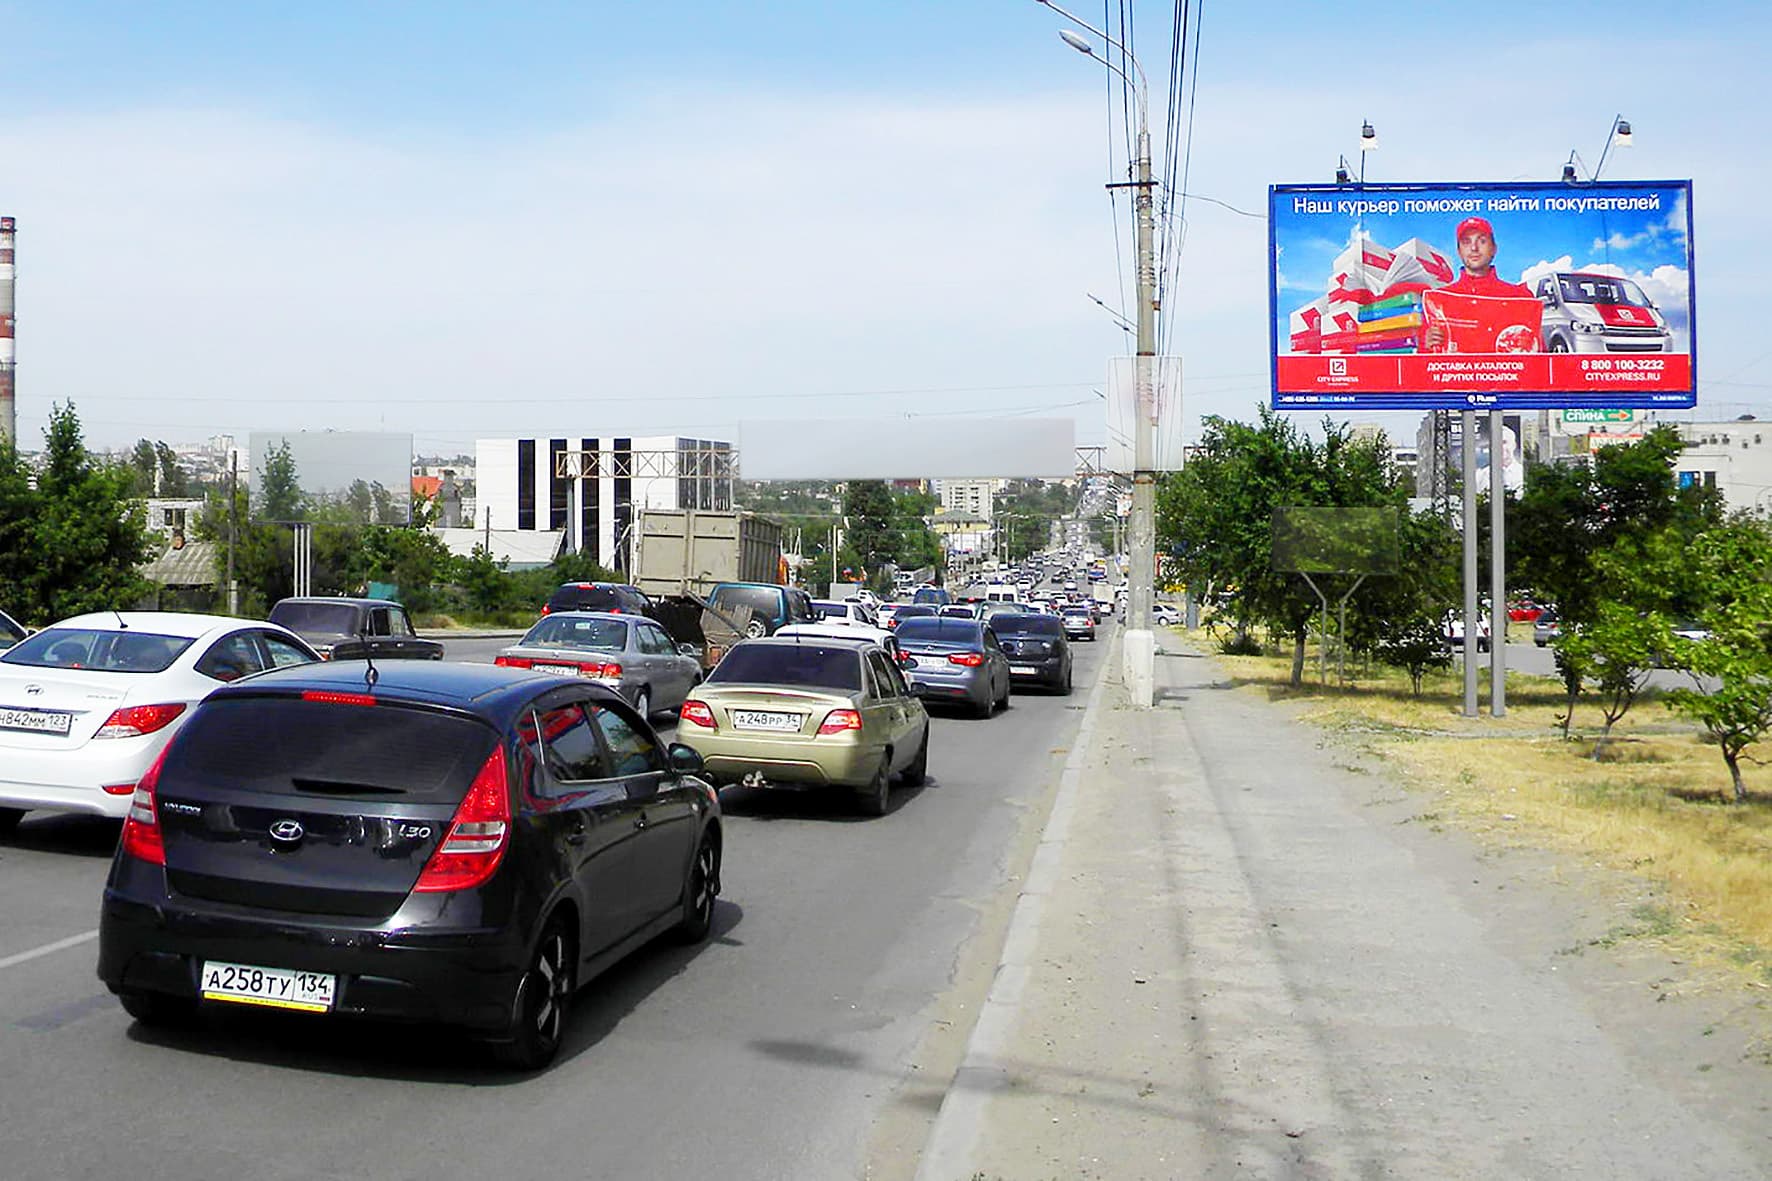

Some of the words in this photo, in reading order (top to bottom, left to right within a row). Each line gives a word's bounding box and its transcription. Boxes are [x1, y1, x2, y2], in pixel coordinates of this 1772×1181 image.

[1294, 198, 1332, 213] Наш
[1338, 199, 1399, 216] курьер
[1404, 199, 1483, 213] поможет
[1487, 195, 1539, 211] найти
[1544, 194, 1660, 214] покупателей
[1427, 362, 1472, 371] ДОСТАВКА
[1474, 361, 1524, 371] КАТАЛОГОВ
[1581, 360, 1589, 370] 8
[1591, 360, 1611, 370] 800
[1615, 360, 1664, 370] 100-3232
[1433, 373, 1440, 381] И
[1441, 373, 1474, 382] ДРУГИХ
[1475, 373, 1519, 381] ПОСЫЛОК
[1584, 372, 1660, 381] CITYEXPRESS.RU
[1566, 412, 1605, 421] СПИНА
[738, 713, 783, 725] А248РР
[207, 966, 291, 996] А258ТУ
[297, 972, 329, 995] 134
